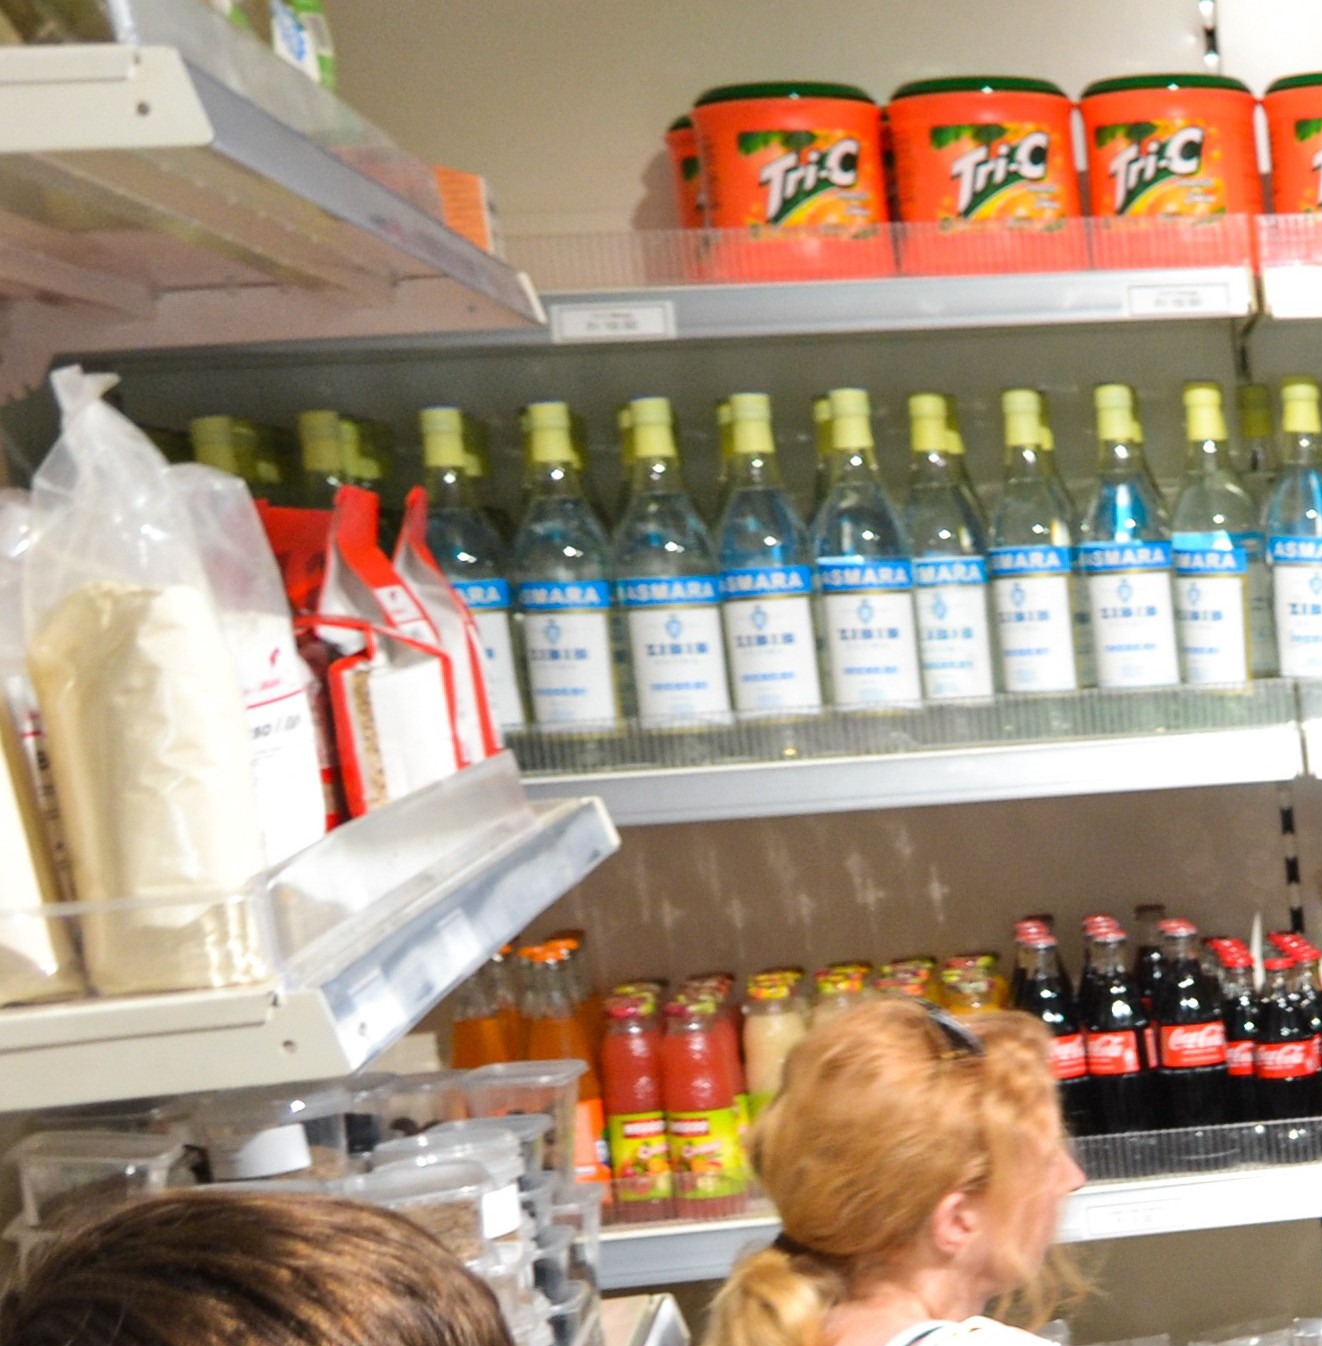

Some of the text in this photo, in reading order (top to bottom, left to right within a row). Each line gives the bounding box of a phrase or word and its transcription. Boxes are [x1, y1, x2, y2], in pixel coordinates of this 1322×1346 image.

[759, 138, 860, 222] Tri-C
[951, 132, 1050, 216] Tri-C
[1109, 126, 1204, 215] Tri-C
